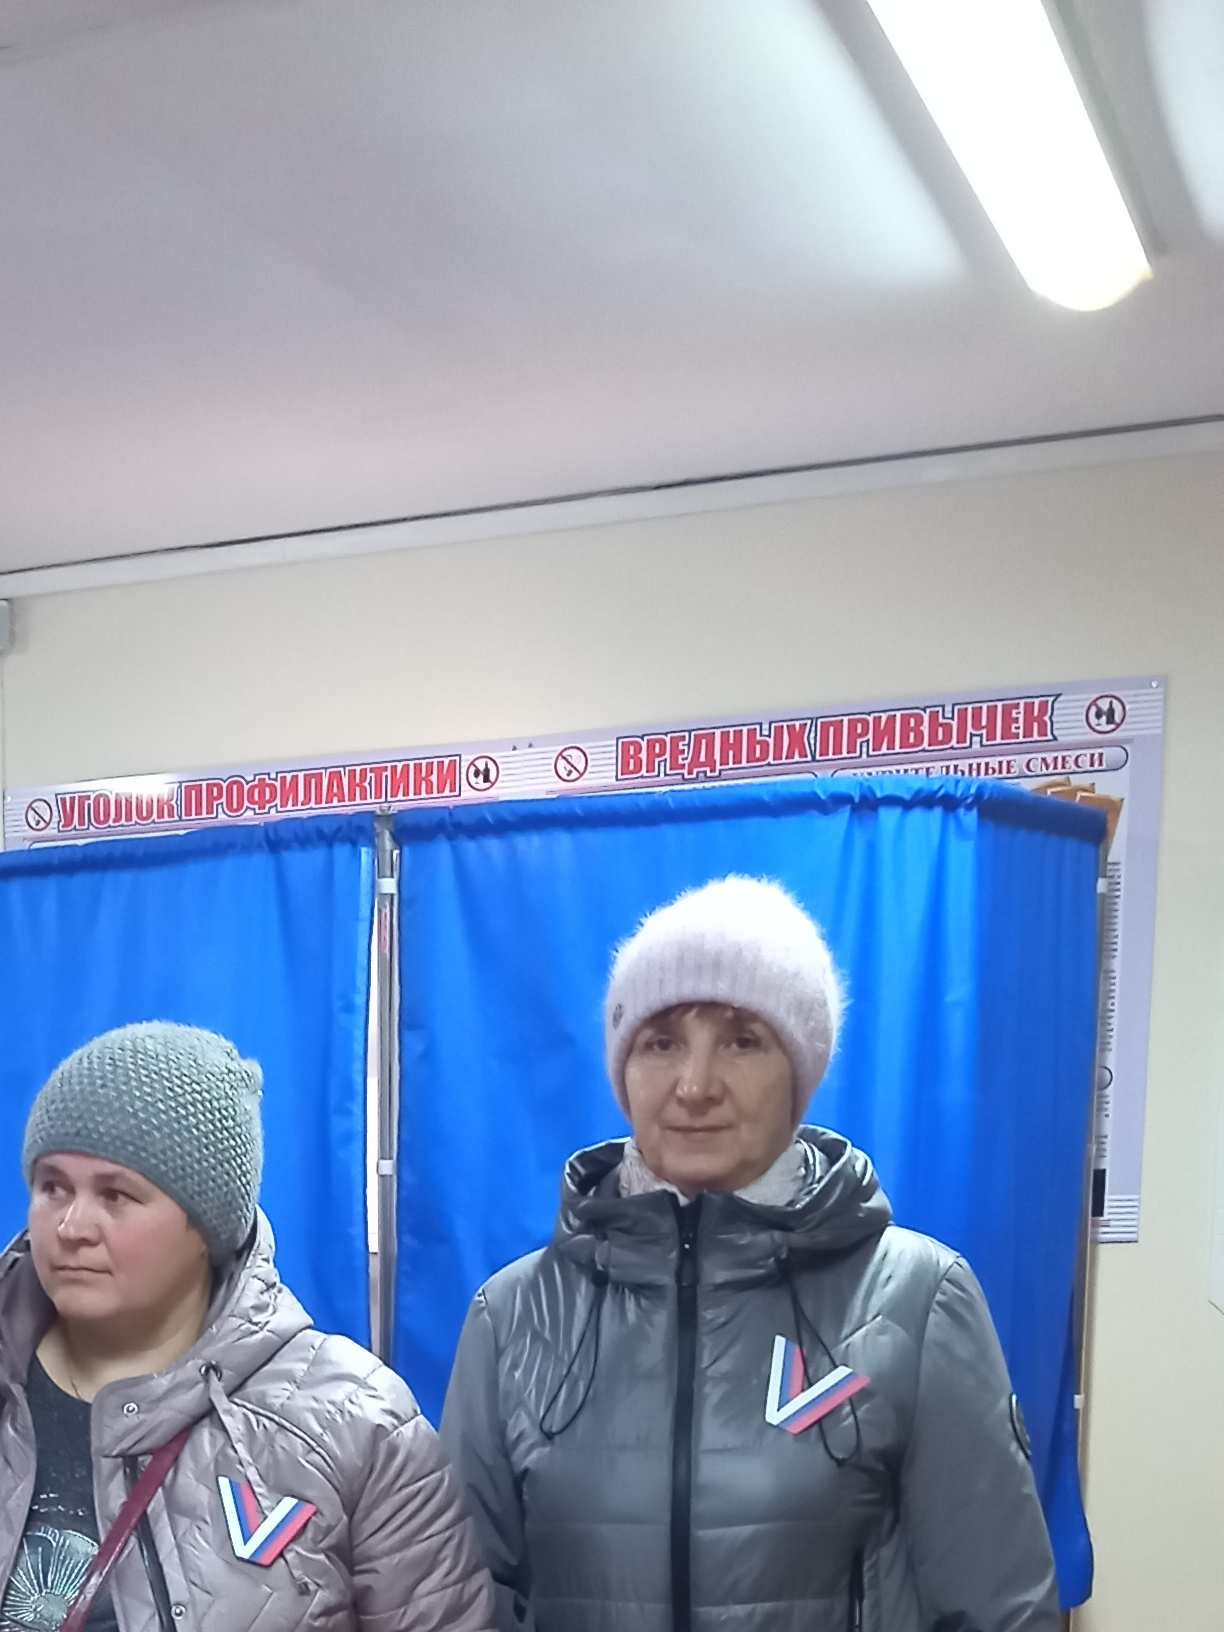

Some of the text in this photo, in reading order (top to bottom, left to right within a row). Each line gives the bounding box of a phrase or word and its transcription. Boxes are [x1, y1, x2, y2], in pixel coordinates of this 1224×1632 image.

[59, 697, 1055, 830] УГОЛОК ПРОФИЛАКТИКИ ВРЕДНЫХ ПРИВЫЧЕК
[1025, 751, 1106, 774] СМЕСИ
